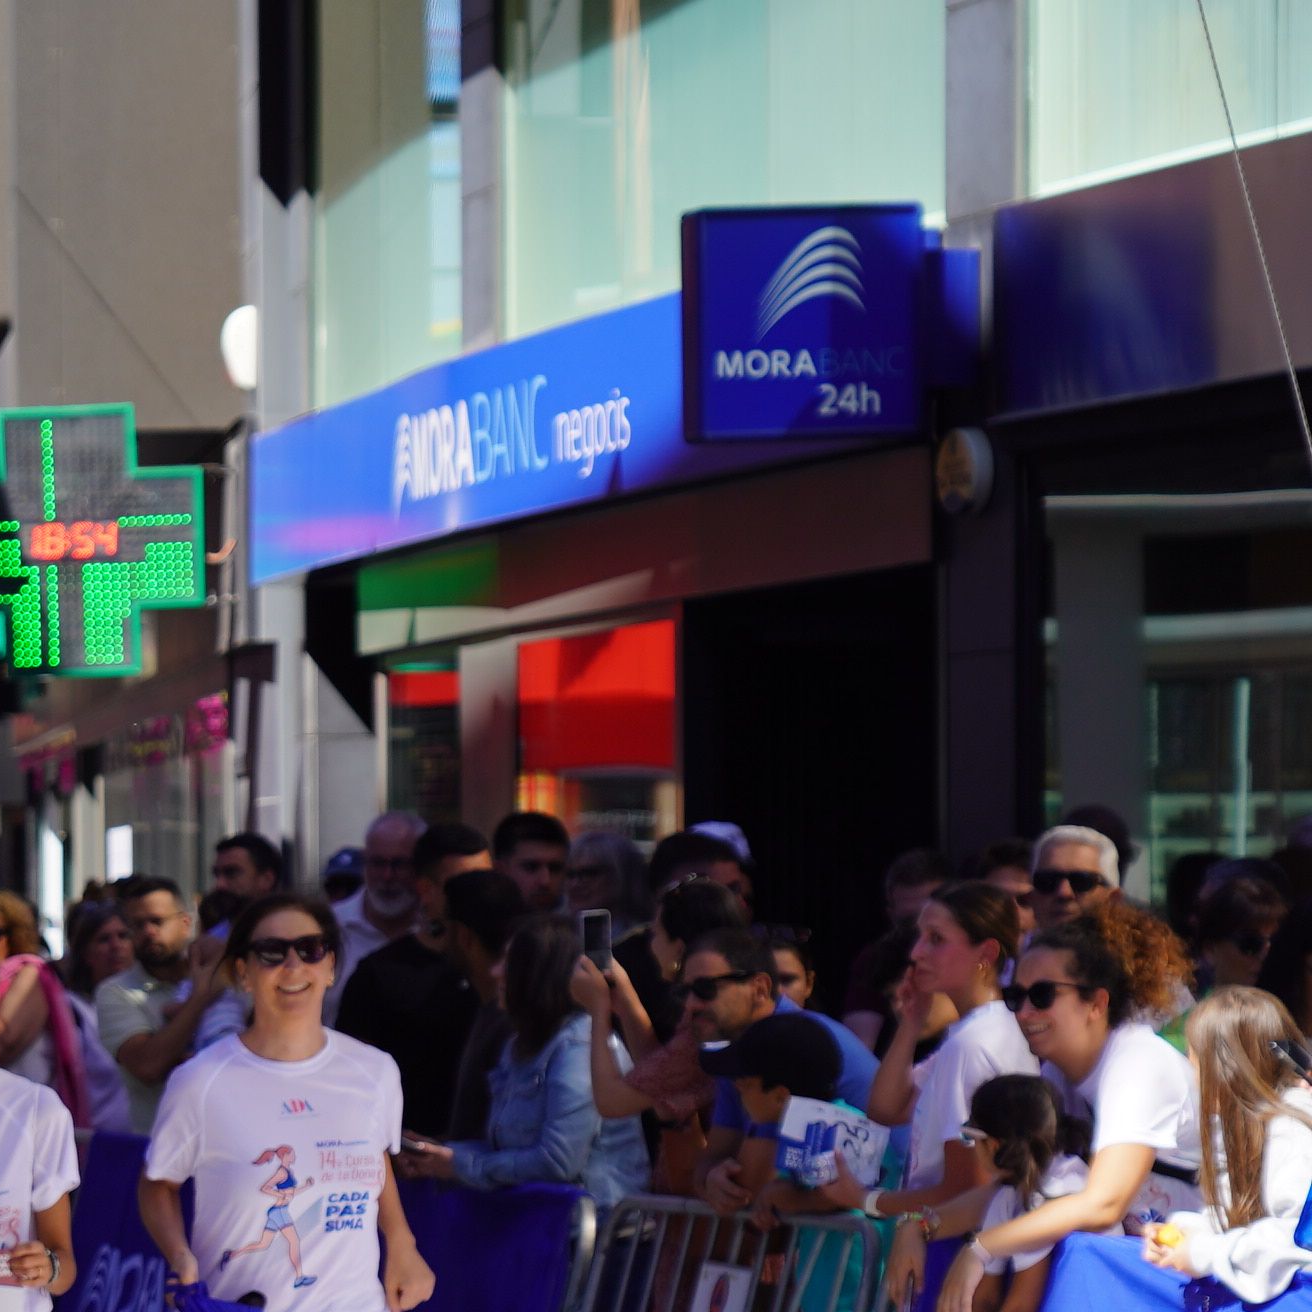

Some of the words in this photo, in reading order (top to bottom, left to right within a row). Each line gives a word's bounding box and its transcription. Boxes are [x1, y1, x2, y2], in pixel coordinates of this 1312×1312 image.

[818, 381, 881, 416] 24h
[327, 1190, 370, 1203] CADA
[325, 1203, 367, 1217] PAS
[324, 1217, 364, 1232] SUMA
